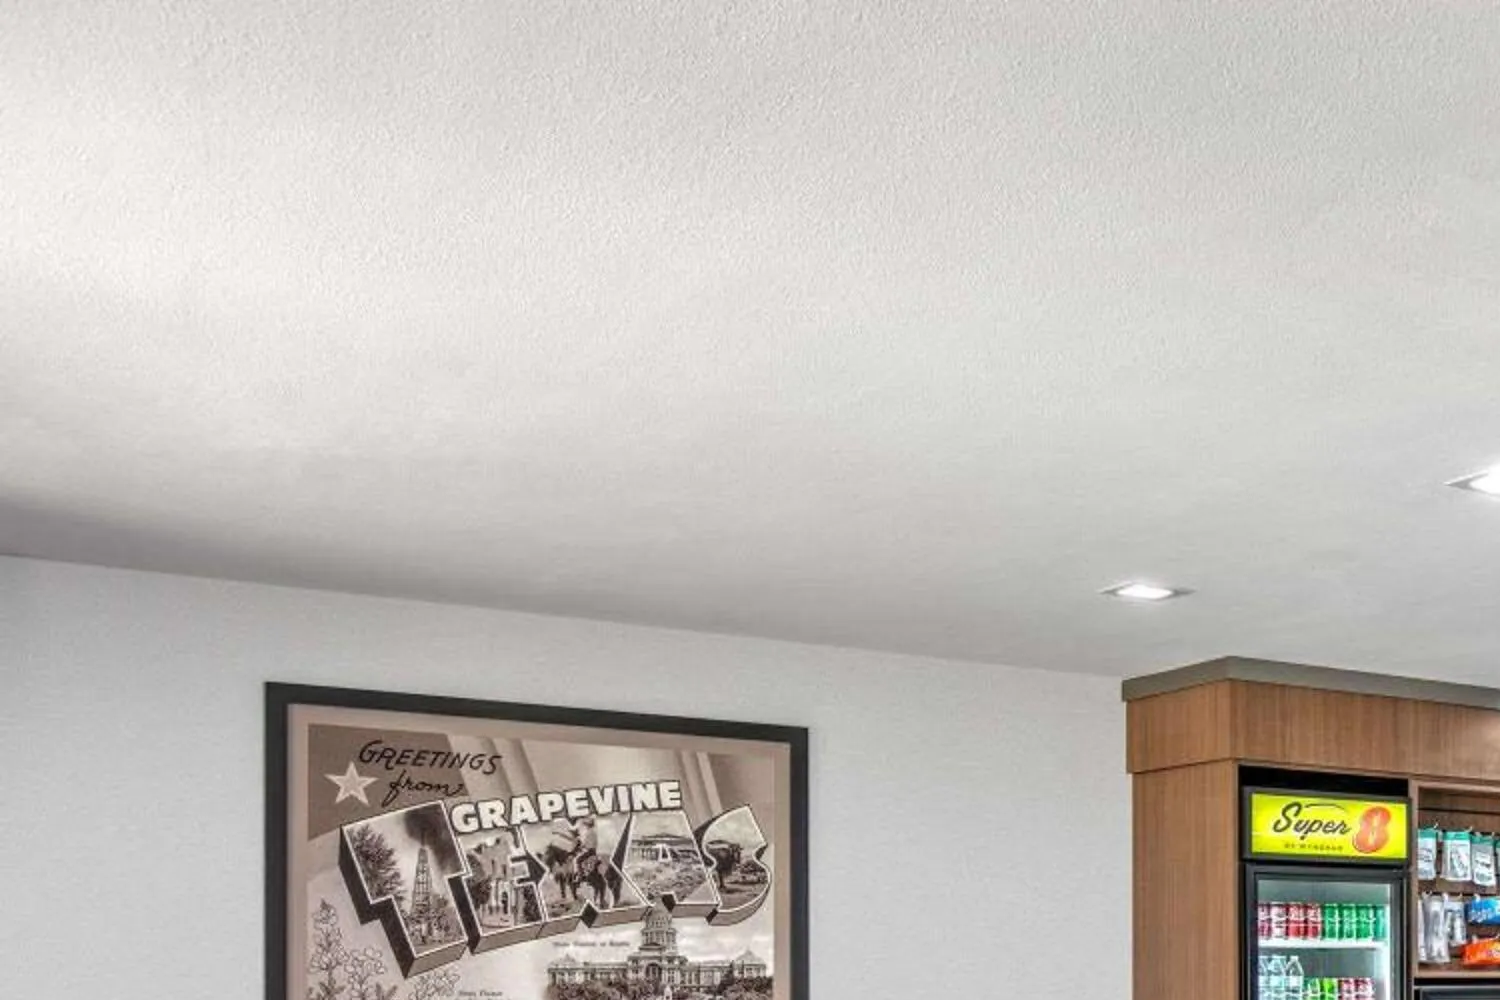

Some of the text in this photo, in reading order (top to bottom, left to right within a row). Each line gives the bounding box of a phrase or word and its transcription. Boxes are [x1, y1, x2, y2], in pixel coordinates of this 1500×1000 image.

[358, 740, 502, 775] GREETINGS
[382, 769, 464, 808] from
[451, 780, 682, 834] GRAPEVINE
[1273, 801, 1392, 853] Super 8
[338, 801, 774, 979] TEXAS
